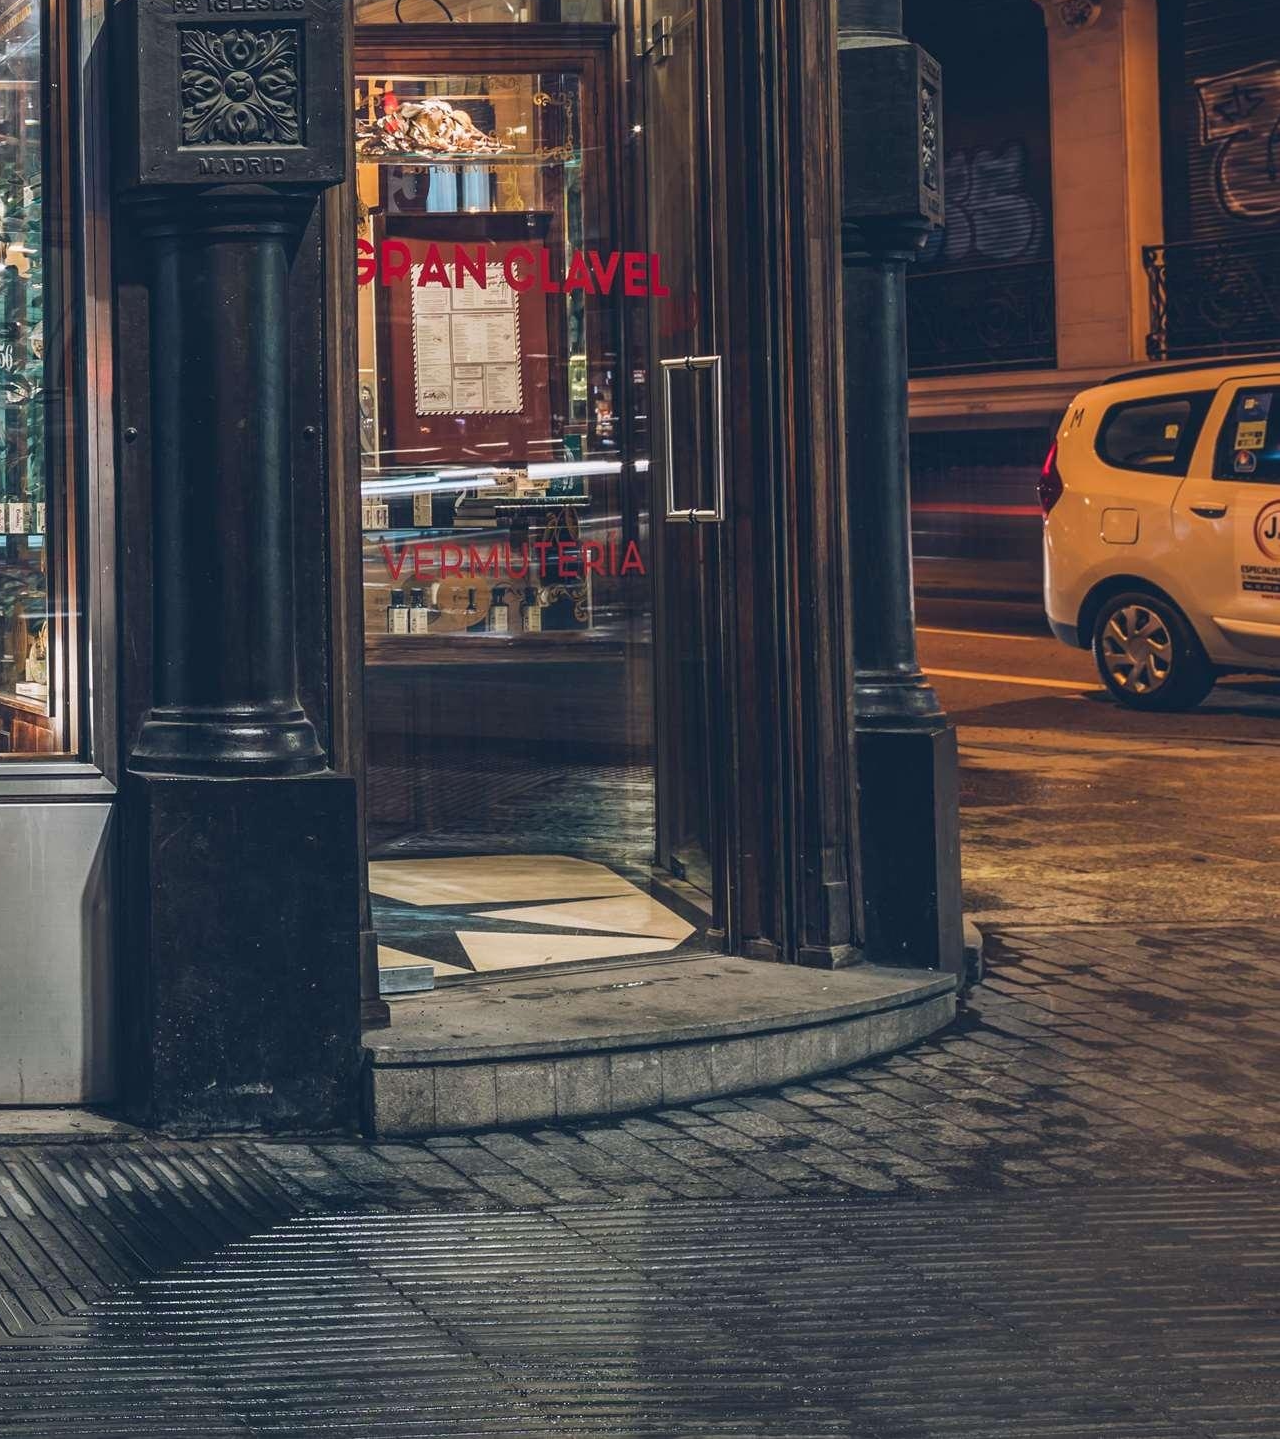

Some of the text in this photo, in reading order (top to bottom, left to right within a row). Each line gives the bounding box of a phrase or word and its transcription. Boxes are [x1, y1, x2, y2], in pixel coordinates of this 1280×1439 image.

[198, 157, 286, 175] MADRID
[356, 238, 487, 290] GRAN
[504, 247, 670, 298] CLAVEL
[378, 530, 646, 580] VERMUTERÍA
